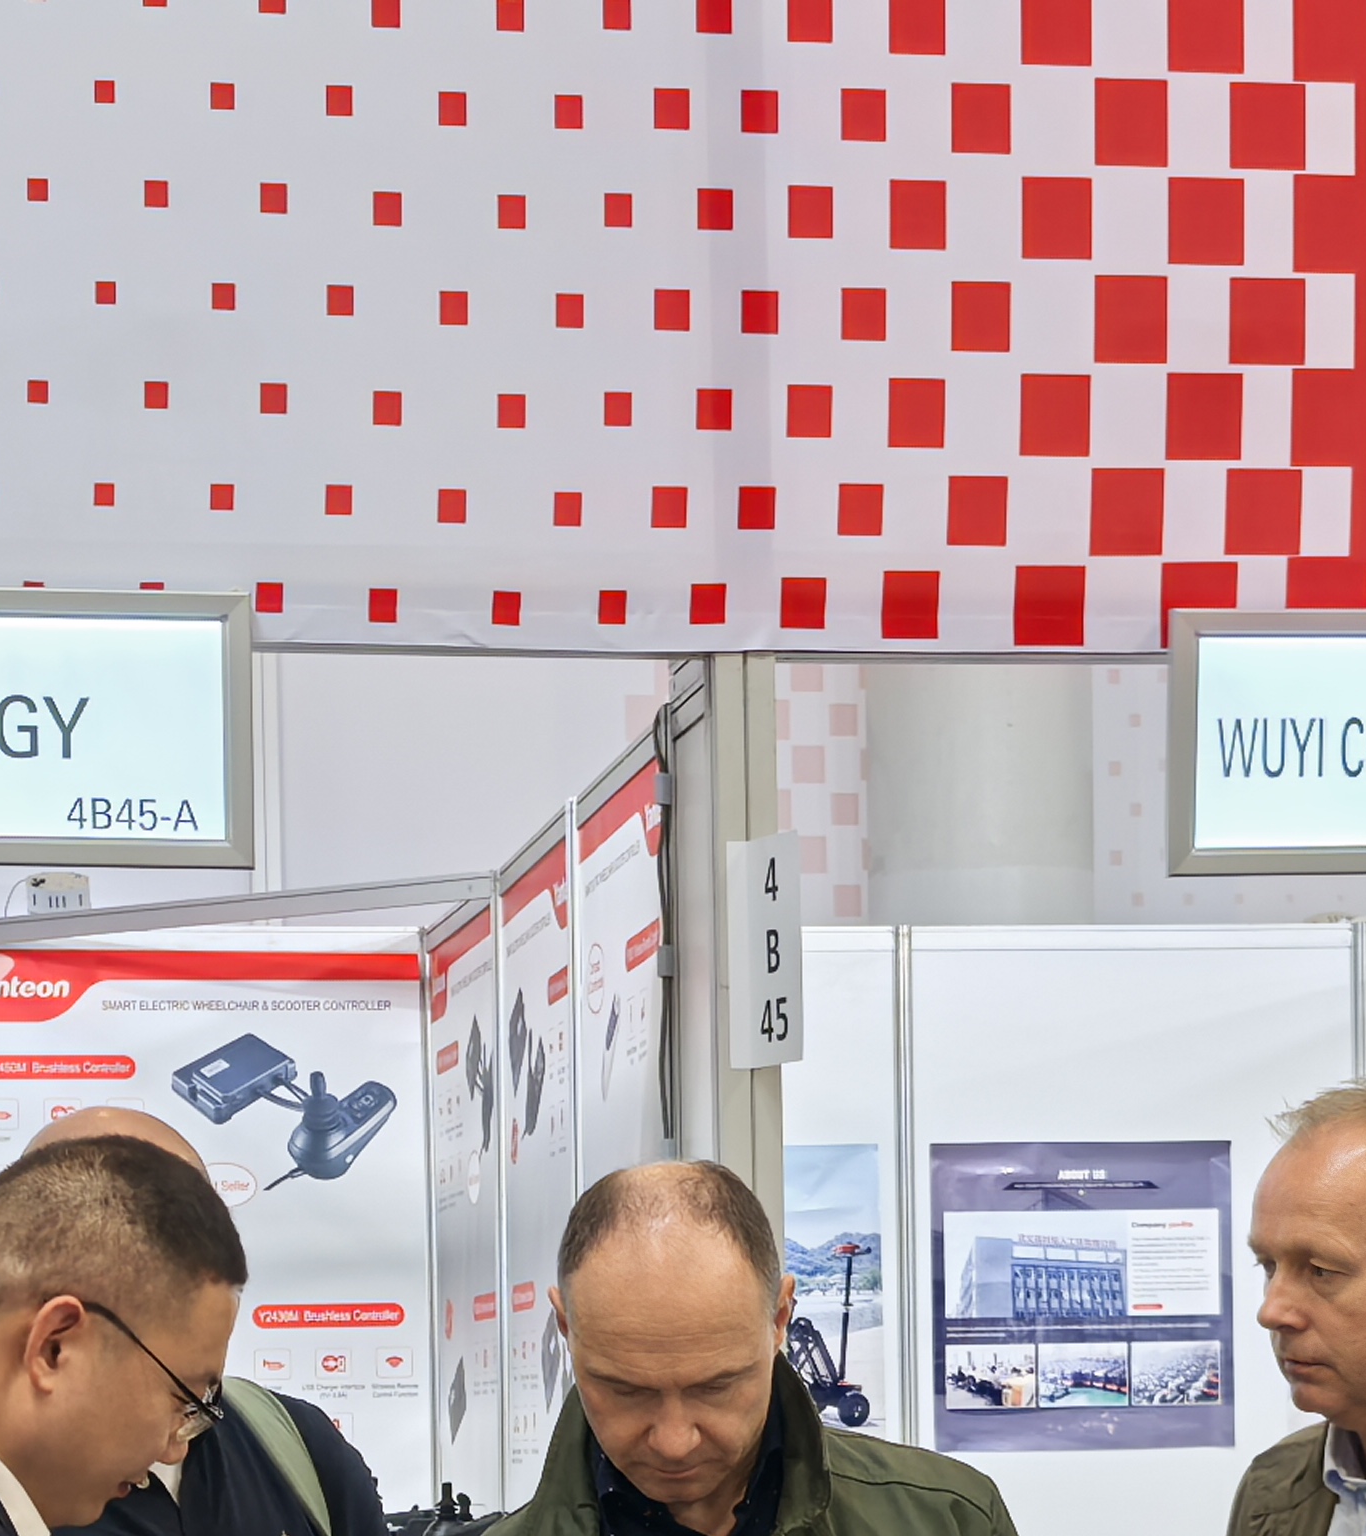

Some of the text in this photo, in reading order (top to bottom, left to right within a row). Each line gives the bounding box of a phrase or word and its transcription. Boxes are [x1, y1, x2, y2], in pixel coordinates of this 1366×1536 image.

[1218, 718, 1325, 780] WUYI
[66, 796, 199, 833] 4B45-A
[763, 857, 779, 902] 4
[766, 930, 780, 975] B
[102, 1000, 136, 1011] SMART
[139, 1000, 190, 1011] ELECTRIC
[192, 1000, 260, 1011] WHEELCHAIR
[270, 1000, 321, 1011] SCOOTER
[323, 1000, 391, 1011] CONTROLLER
[759, 997, 789, 1044] 45
[353, 1309, 400, 1322] Controller
